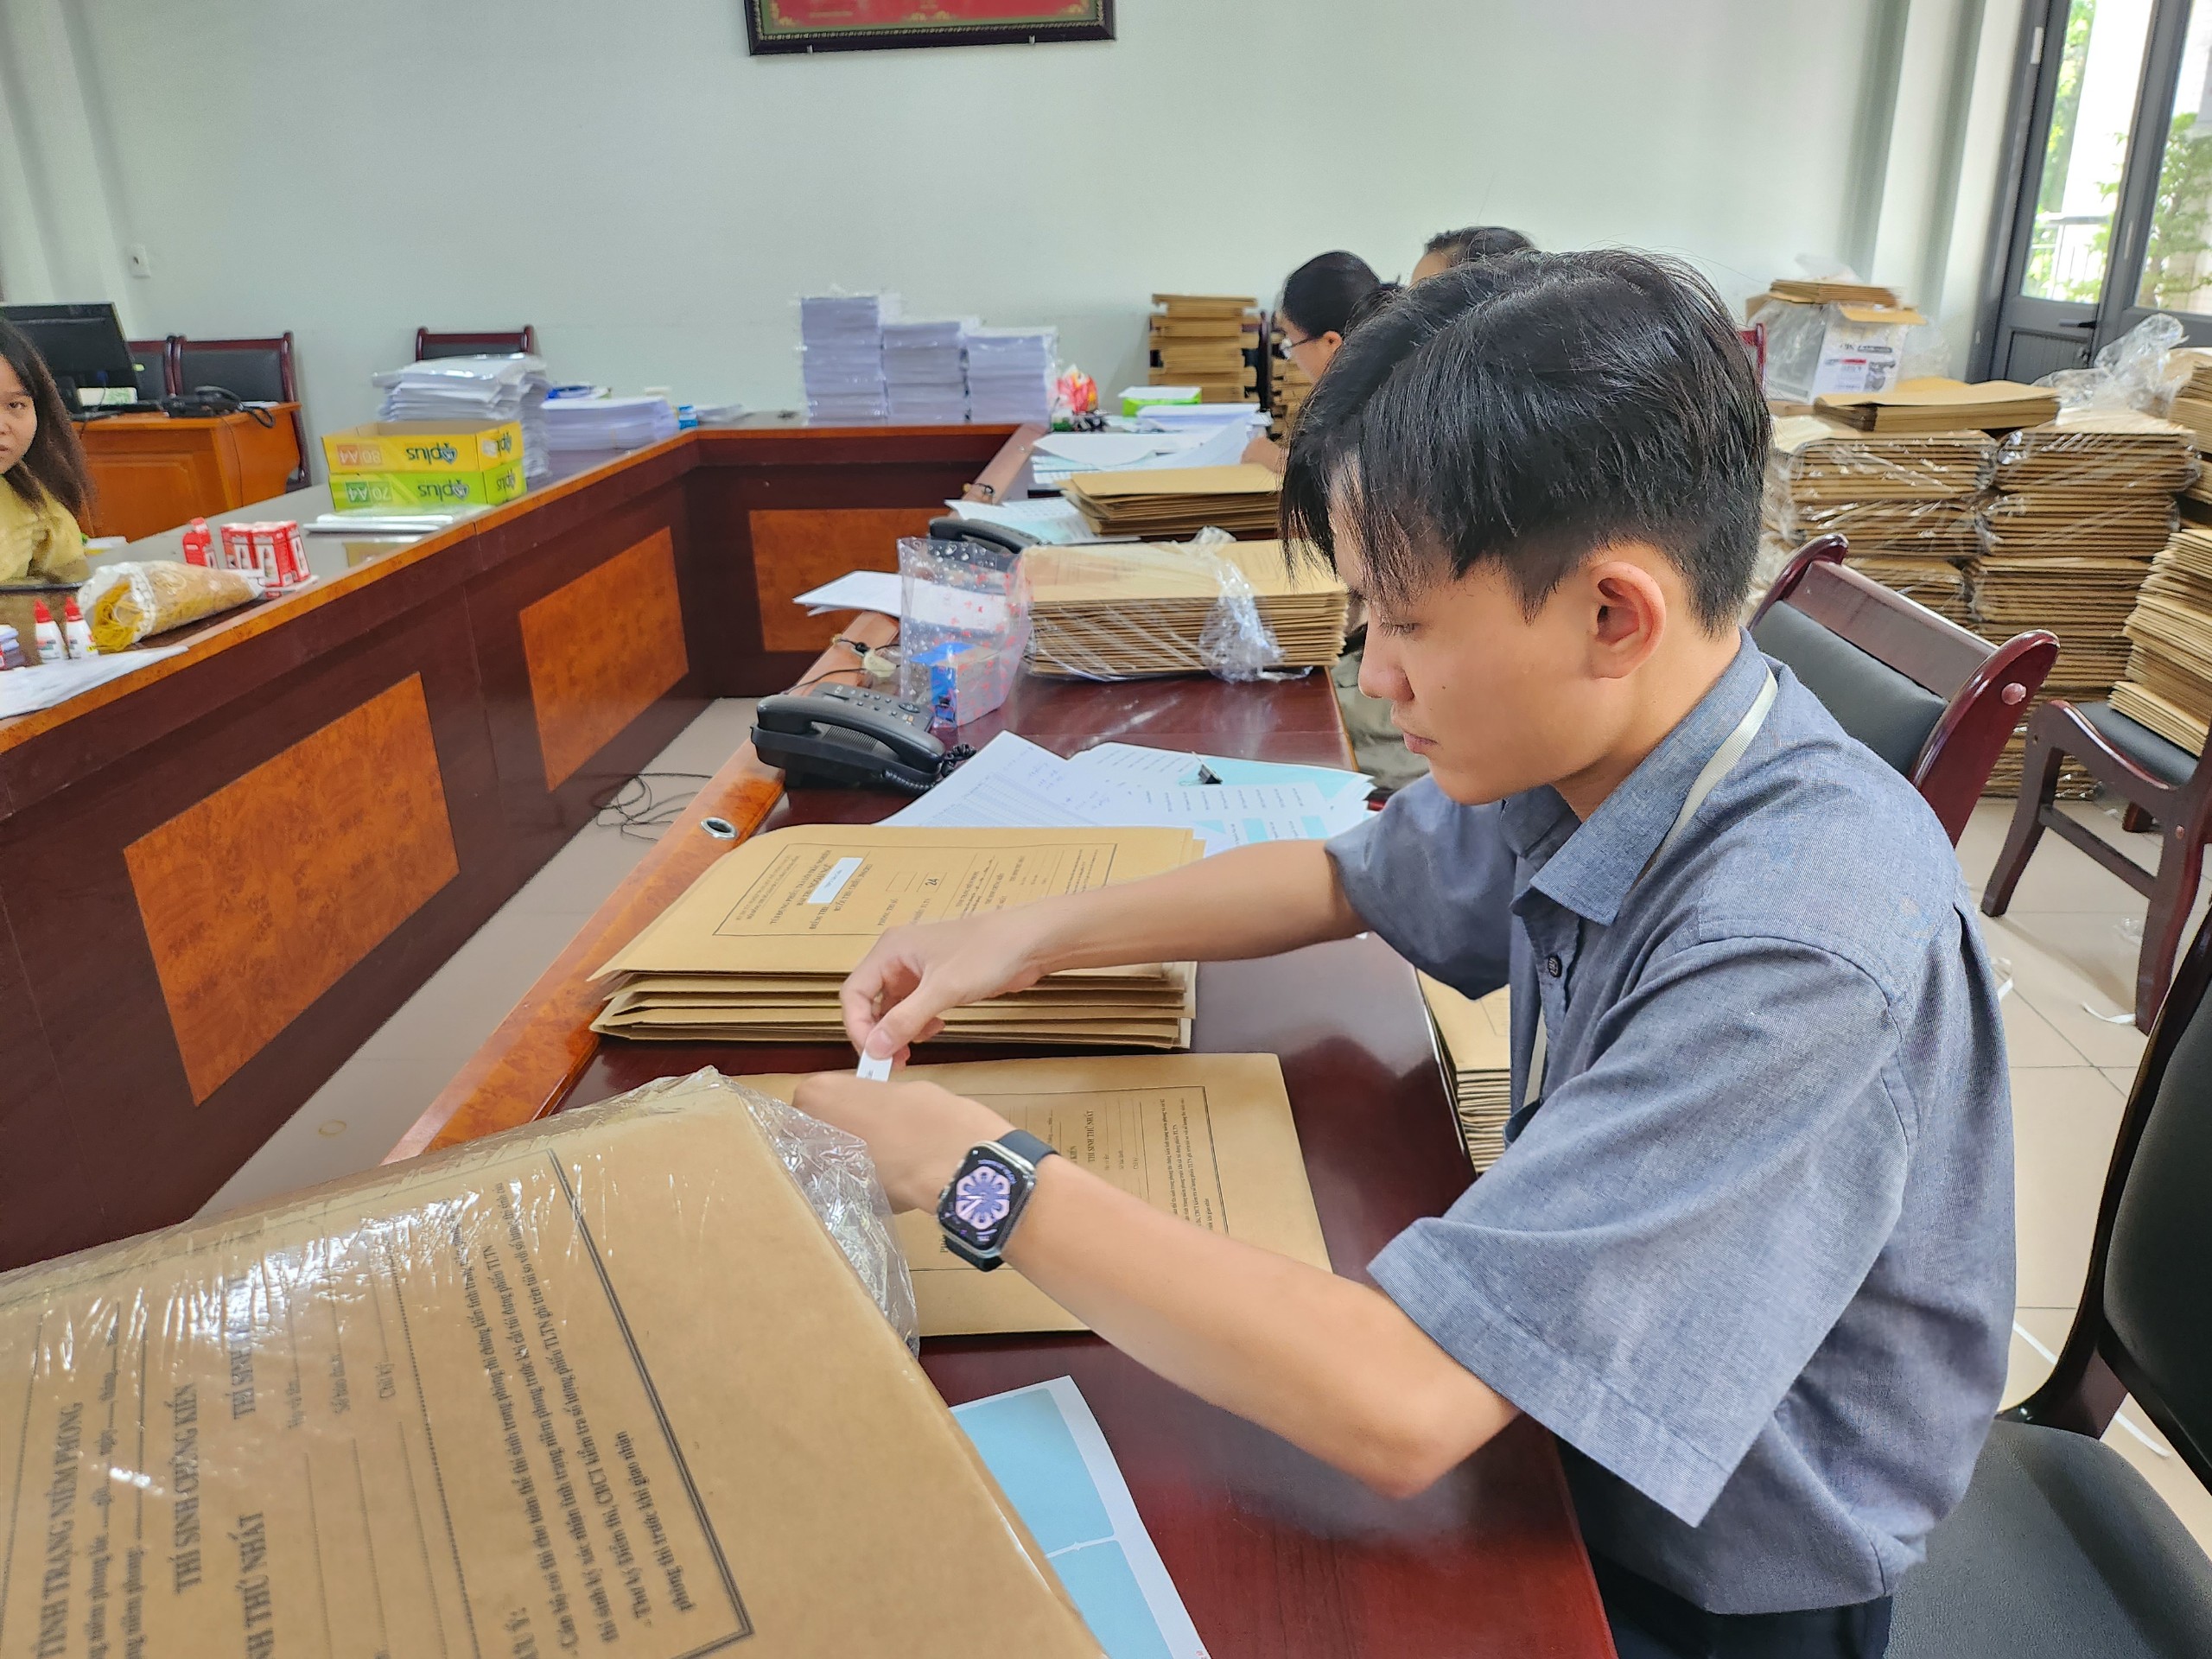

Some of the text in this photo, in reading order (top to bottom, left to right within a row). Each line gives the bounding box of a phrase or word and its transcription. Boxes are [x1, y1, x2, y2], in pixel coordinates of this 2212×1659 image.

[340, 448, 359, 464] A4
[406, 442, 442, 465] plus
[348, 485, 390, 501] 70 A4
[418, 480, 454, 502] plus
[482, 1244, 501, 1270] TLTN
[514, 1250, 529, 1263] với
[522, 1263, 534, 1273] so
[486, 1270, 513, 1293] phiếu
[525, 1273, 537, 1287] túi
[499, 1292, 516, 1315] đựng
[528, 1286, 544, 1305] trên
[468, 1309, 487, 1327] kiến
[532, 1305, 554, 1319] ghi
[473, 1325, 495, 1355] chứng
[538, 1320, 560, 1350] TLTN
[518, 1362, 538, 1386] trước
[544, 1348, 573, 1374] phiếu
[488, 1368, 512, 1402] phòng
[556, 1372, 580, 1405] lượng
[225, 1387, 256, 1420] THÍ
[496, 1399, 517, 1431] trong
[529, 1386, 553, 1419] phong
[563, 1404, 583, 1416] số
[54, 1402, 84, 1465] PHONG
[538, 1420, 558, 1447] niêm
[575, 1417, 590, 1435] tra
[504, 1432, 524, 1455] sinh
[576, 1435, 601, 1465] kiểm
[614, 1431, 636, 1461] nhận
[587, 1467, 617, 1507] CBCT
[627, 1461, 650, 1487] giao
[44, 1465, 79, 1520] NIÊM
[164, 1384, 202, 1594] THÍ SINH CHỨNG KIẾN
[632, 1488, 654, 1511] khi
[643, 1510, 667, 1545] trước
[227, 1511, 267, 1573] NHẤT
[41, 1520, 78, 1599] TRẠNG
[235, 1575, 273, 1630] THỨ
